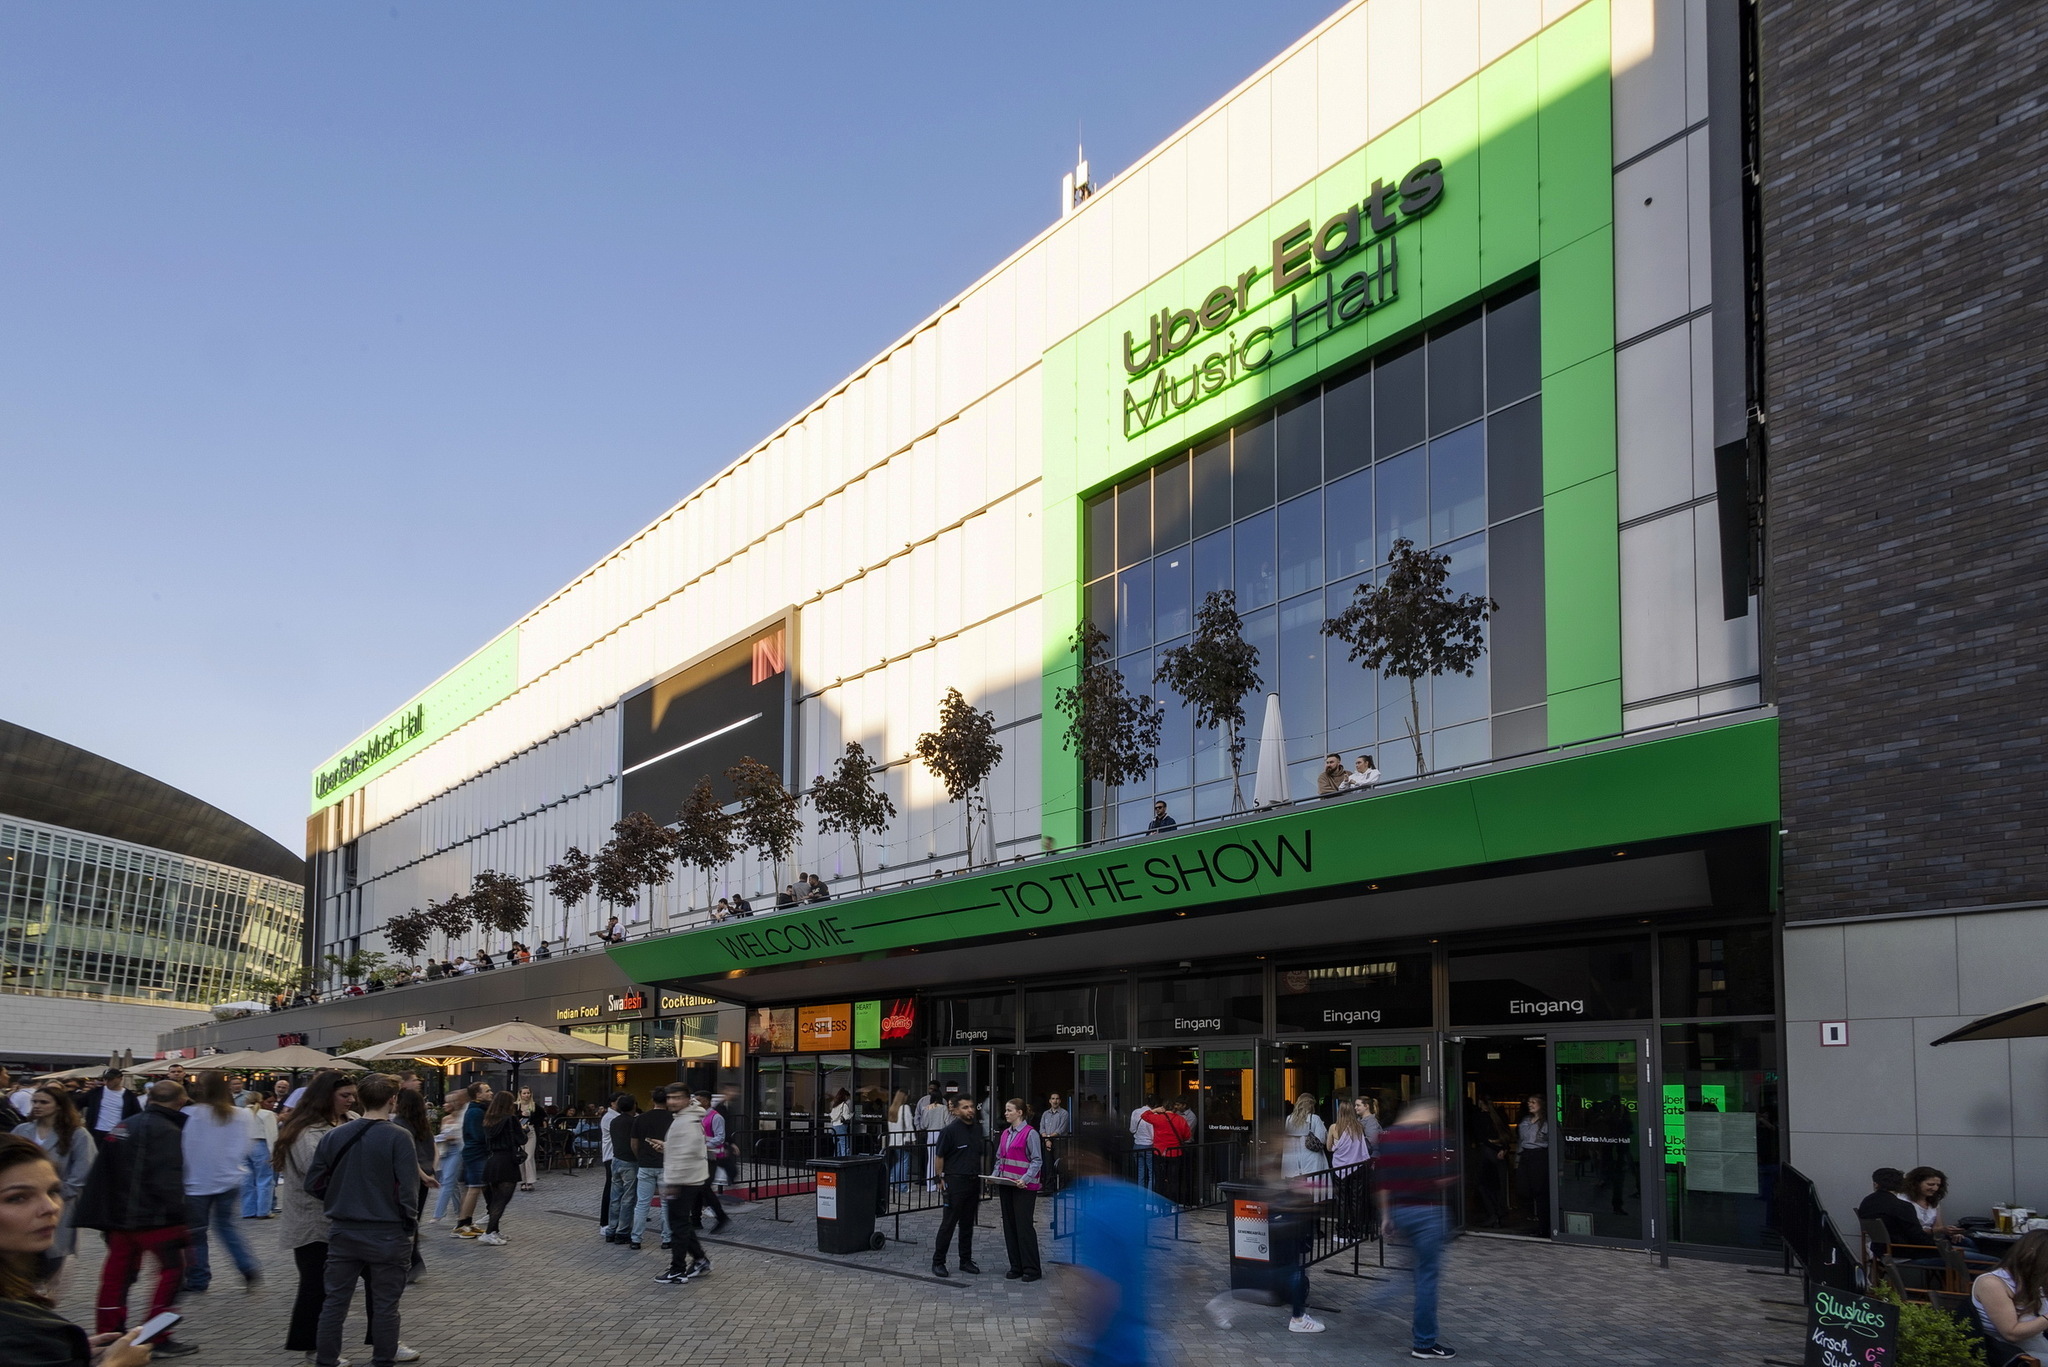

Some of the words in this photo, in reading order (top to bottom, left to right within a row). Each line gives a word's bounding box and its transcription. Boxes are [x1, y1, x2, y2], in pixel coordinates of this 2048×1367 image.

[1123, 265, 1258, 375] Uber
[1272, 158, 1446, 293] Eats
[1123, 326, 1275, 438] Music
[1291, 235, 1398, 349] Hall
[752, 629, 785, 686] N
[316, 768, 340, 799] Uber
[339, 750, 367, 784] Eats
[366, 725, 400, 765] Music
[401, 703, 424, 743] Hall
[716, 917, 854, 961] WELCOME
[991, 880, 1053, 918] TO
[1049, 863, 1142, 909] THE
[1144, 830, 1313, 896] SHOW
[608, 991, 642, 1012] Swadesh
[1510, 1000, 1584, 1016] Eingang
[556, 1009, 579, 1020] Indian
[580, 1005, 600, 1018] Food
[1323, 1009, 1381, 1024] Eingang
[801, 1020, 848, 1034] CASHLESS
[1056, 1024, 1094, 1036] Eingang
[1174, 1018, 1221, 1031] Eingang
[955, 1030, 988, 1041] Eingang
[1582, 1135, 1599, 1143] Eats
[1599, 1136, 1618, 1144] Music
[1815, 1291, 1886, 1329] Slushies
[1811, 1326, 1853, 1357] Kirsch
